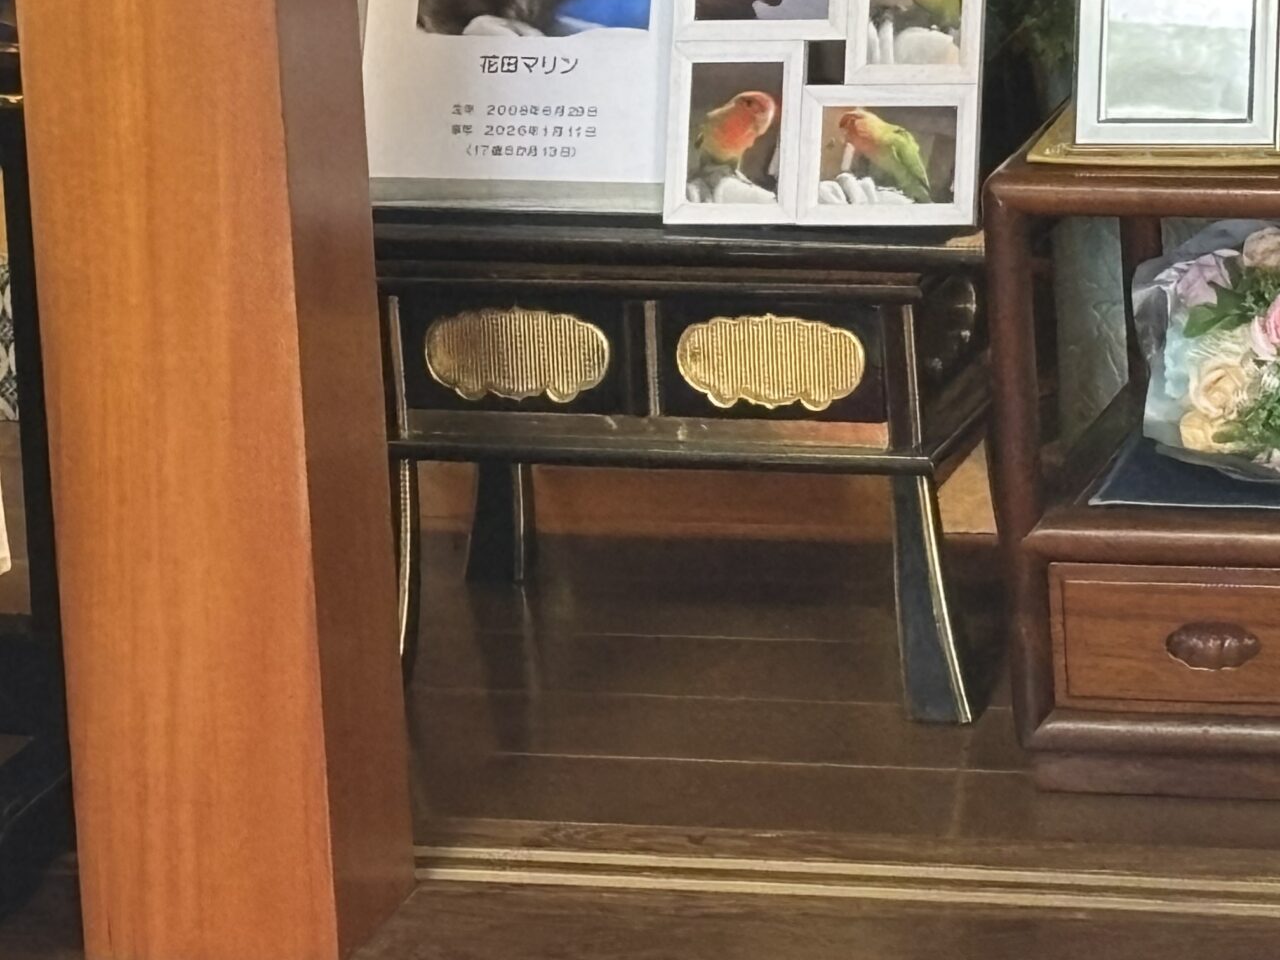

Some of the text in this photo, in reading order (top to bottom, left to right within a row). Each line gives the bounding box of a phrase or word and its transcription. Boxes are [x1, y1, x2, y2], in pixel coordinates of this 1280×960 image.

[479, 54, 579, 75] 花田マリン
